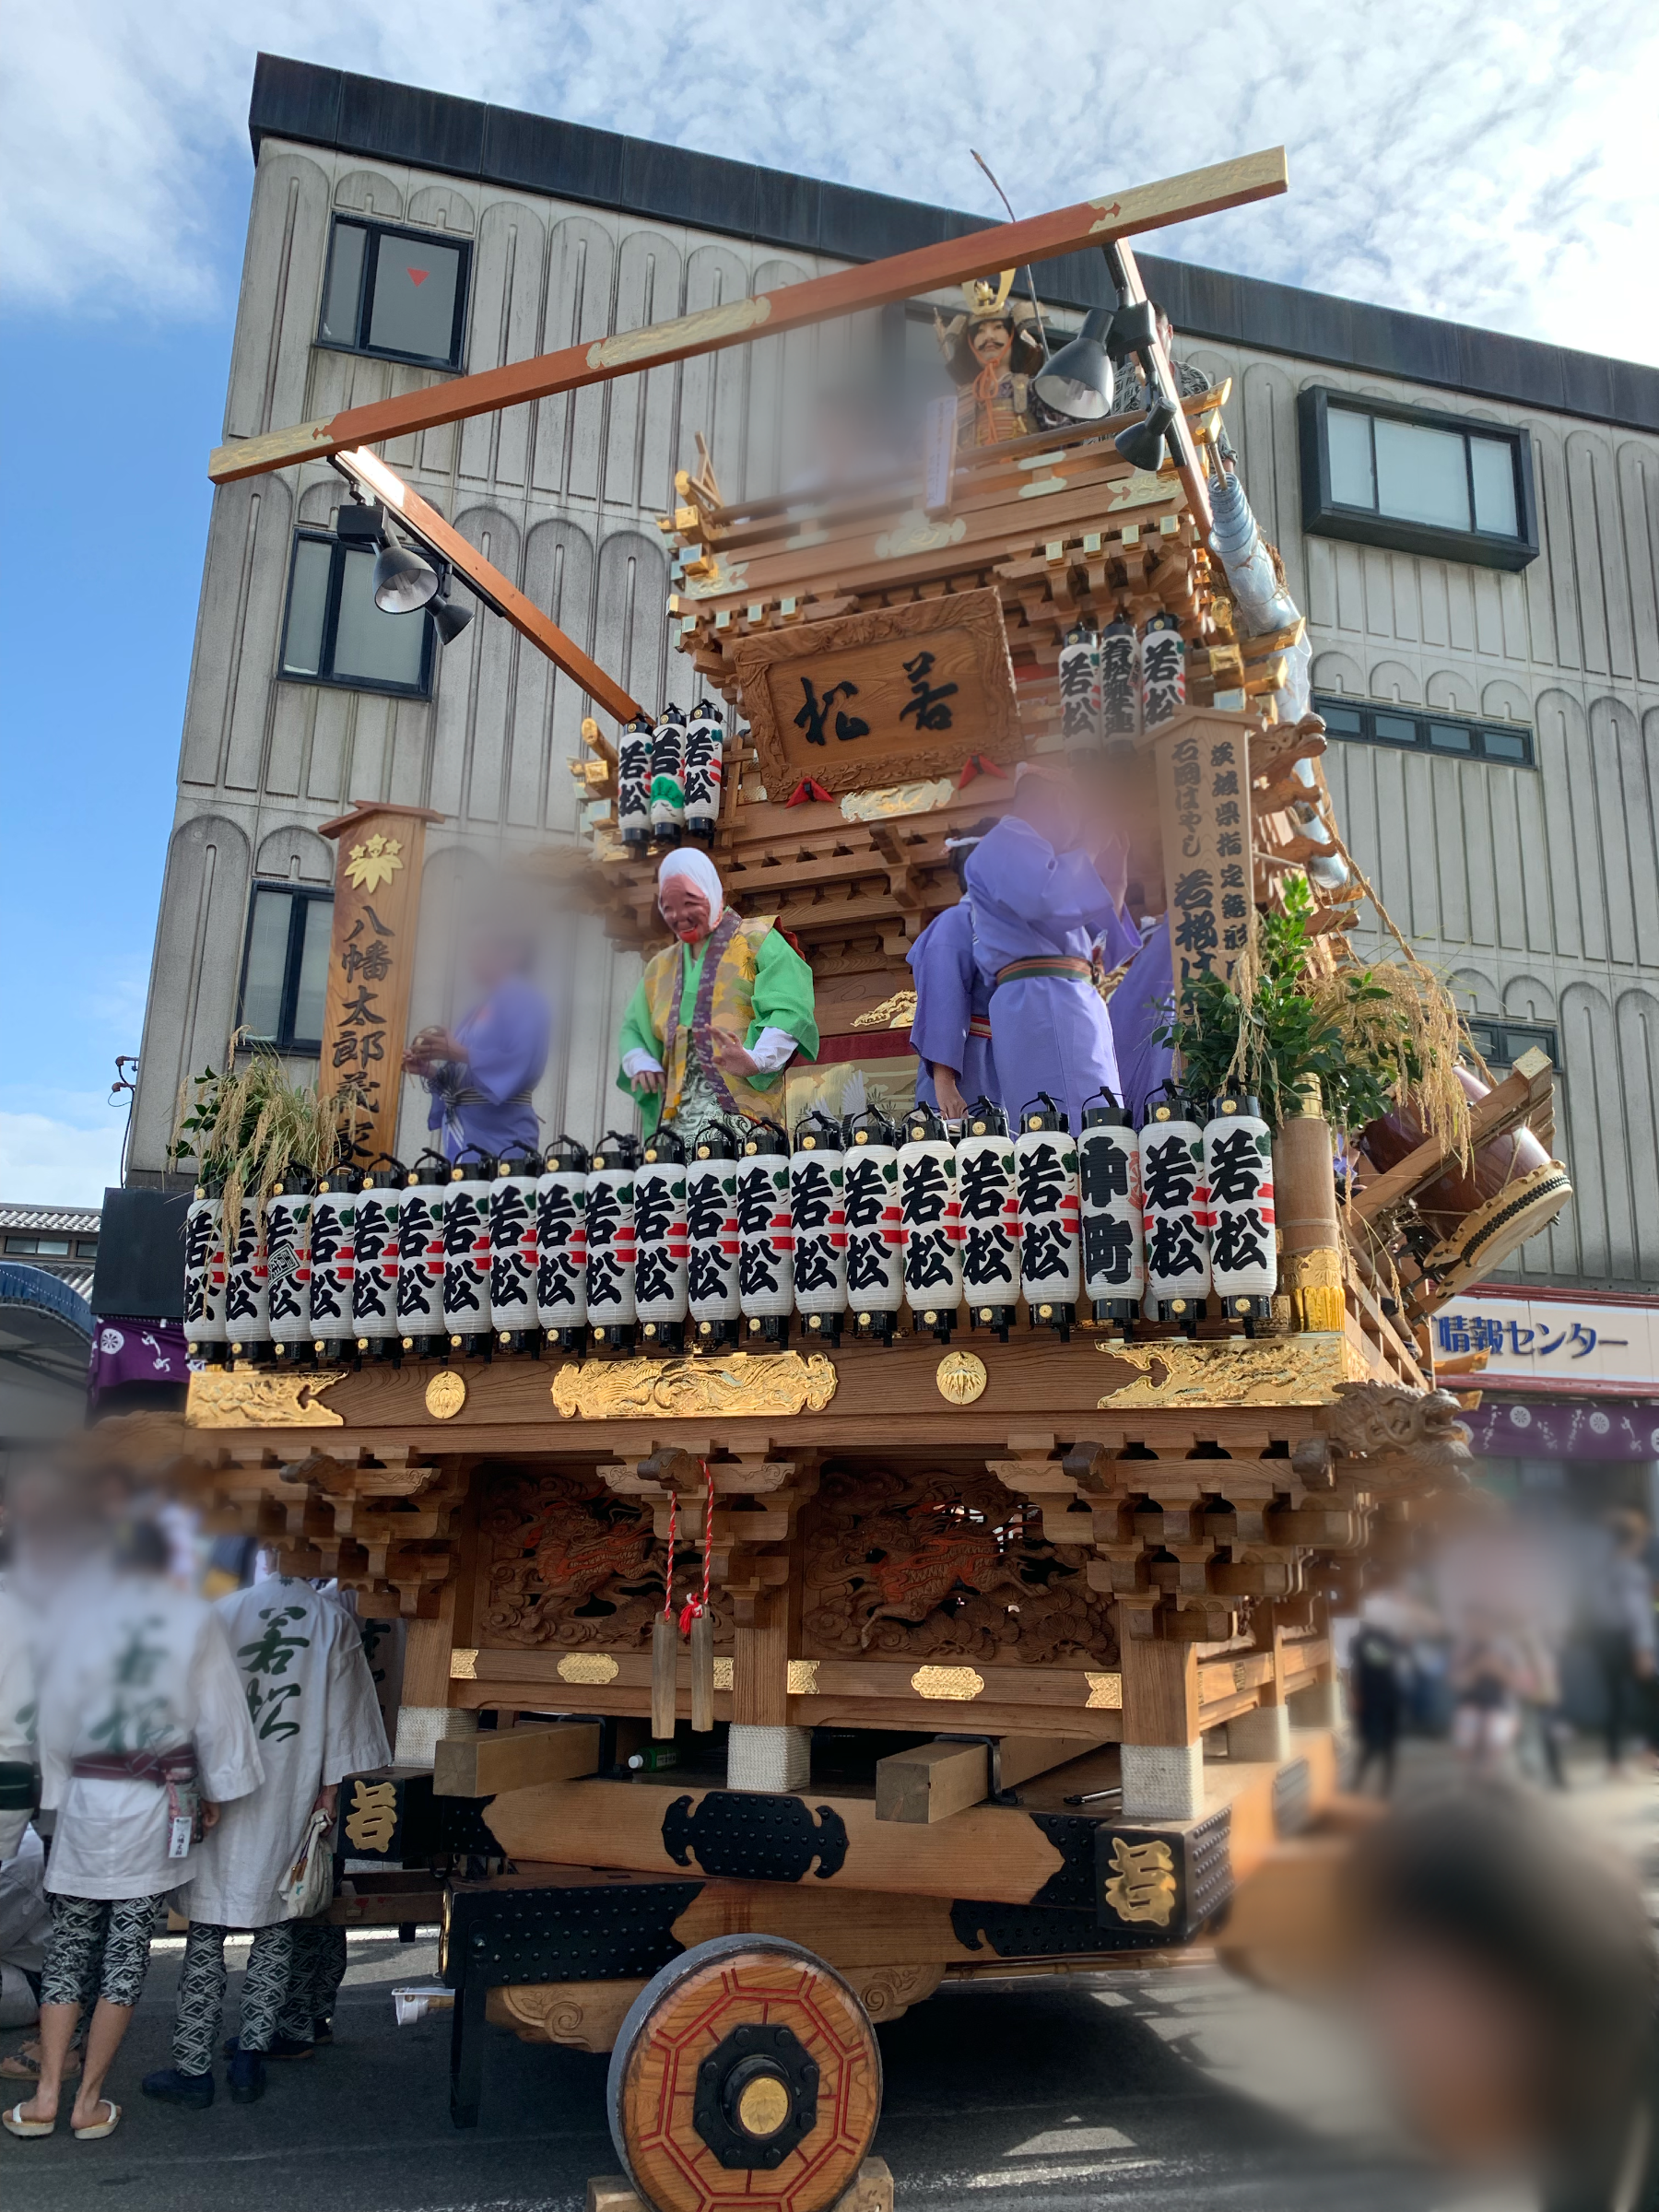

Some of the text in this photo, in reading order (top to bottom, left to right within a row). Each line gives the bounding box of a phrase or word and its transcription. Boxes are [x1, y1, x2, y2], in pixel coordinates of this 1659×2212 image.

[793, 650, 959, 747] 若松
[1060, 652, 1098, 738] 若松
[1143, 637, 1183, 725] 若松
[618, 739, 651, 818] 若松
[684, 725, 716, 806] 若松
[1210, 741, 1249, 980] 茨城県指定無形
[330, 905, 396, 1159] 八幡太郎義家
[265, 1204, 305, 1323] 若松
[308, 1205, 347, 1322] 若松
[353, 1200, 391, 1320] 若松
[397, 1197, 437, 1318] 若松
[441, 1193, 485, 1314] 若松
[489, 1185, 533, 1308] 若松
[536, 1184, 581, 1309] 若松
[585, 1182, 627, 1308] 若松
[634, 1176, 680, 1304] 若松
[686, 1174, 734, 1303] 若松
[736, 1166, 782, 1297] 若松
[791, 1162, 841, 1294] 若松
[844, 1159, 894, 1292] 若松
[900, 1155, 957, 1290] 若松
[959, 1149, 1014, 1286] 若松
[1018, 1143, 1073, 1283] 若松
[1080, 1136, 1134, 1286] 中町
[1144, 1135, 1205, 1278] 若松
[1208, 1128, 1271, 1274] 若松
[184, 1207, 220, 1324] 若松
[225, 1208, 264, 1323] 若松
[1431, 1314, 1630, 1359] 情報センター
[236, 1606, 311, 1743] 若松
